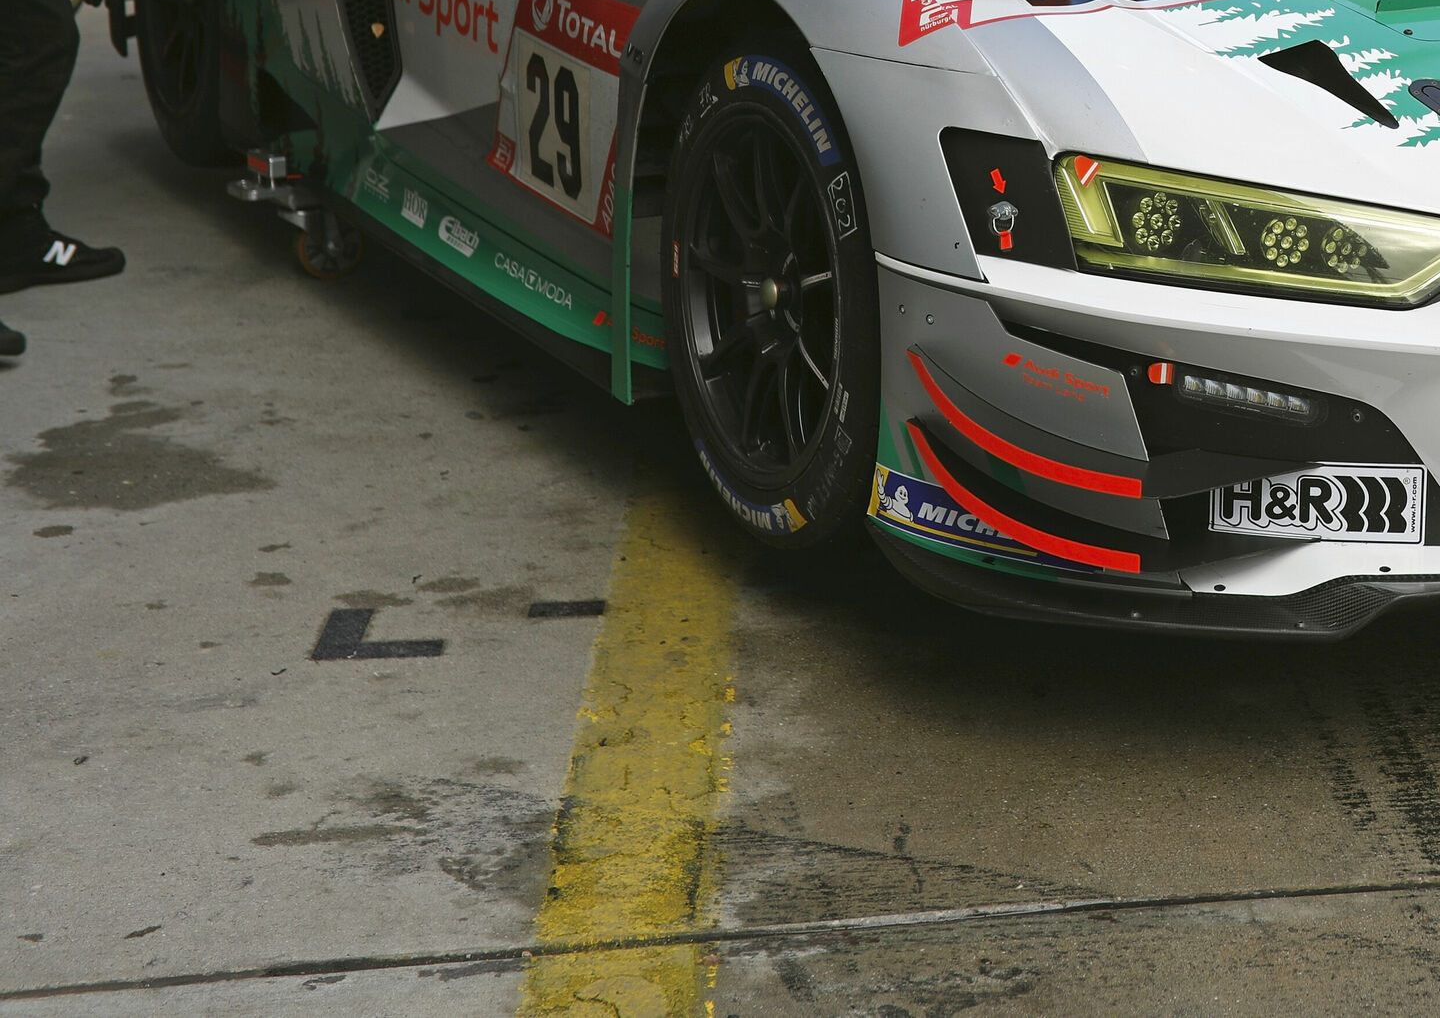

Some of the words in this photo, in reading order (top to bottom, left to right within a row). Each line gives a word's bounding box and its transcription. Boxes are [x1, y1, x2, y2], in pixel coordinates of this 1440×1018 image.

[527, 52, 582, 201] 29
[752, 61, 832, 153] MICHELIN
[440, 215, 480, 249] Eibach
[494, 252, 526, 283] CASA
[535, 280, 572, 310] MODA
[1022, 373, 1053, 390] Team
[1056, 381, 1086, 402] Land
[1023, 359, 1061, 380] Audi
[1064, 372, 1111, 397] Sport
[1221, 478, 1335, 525] H&R
[1410, 476, 1419, 534] www.h-r.com
